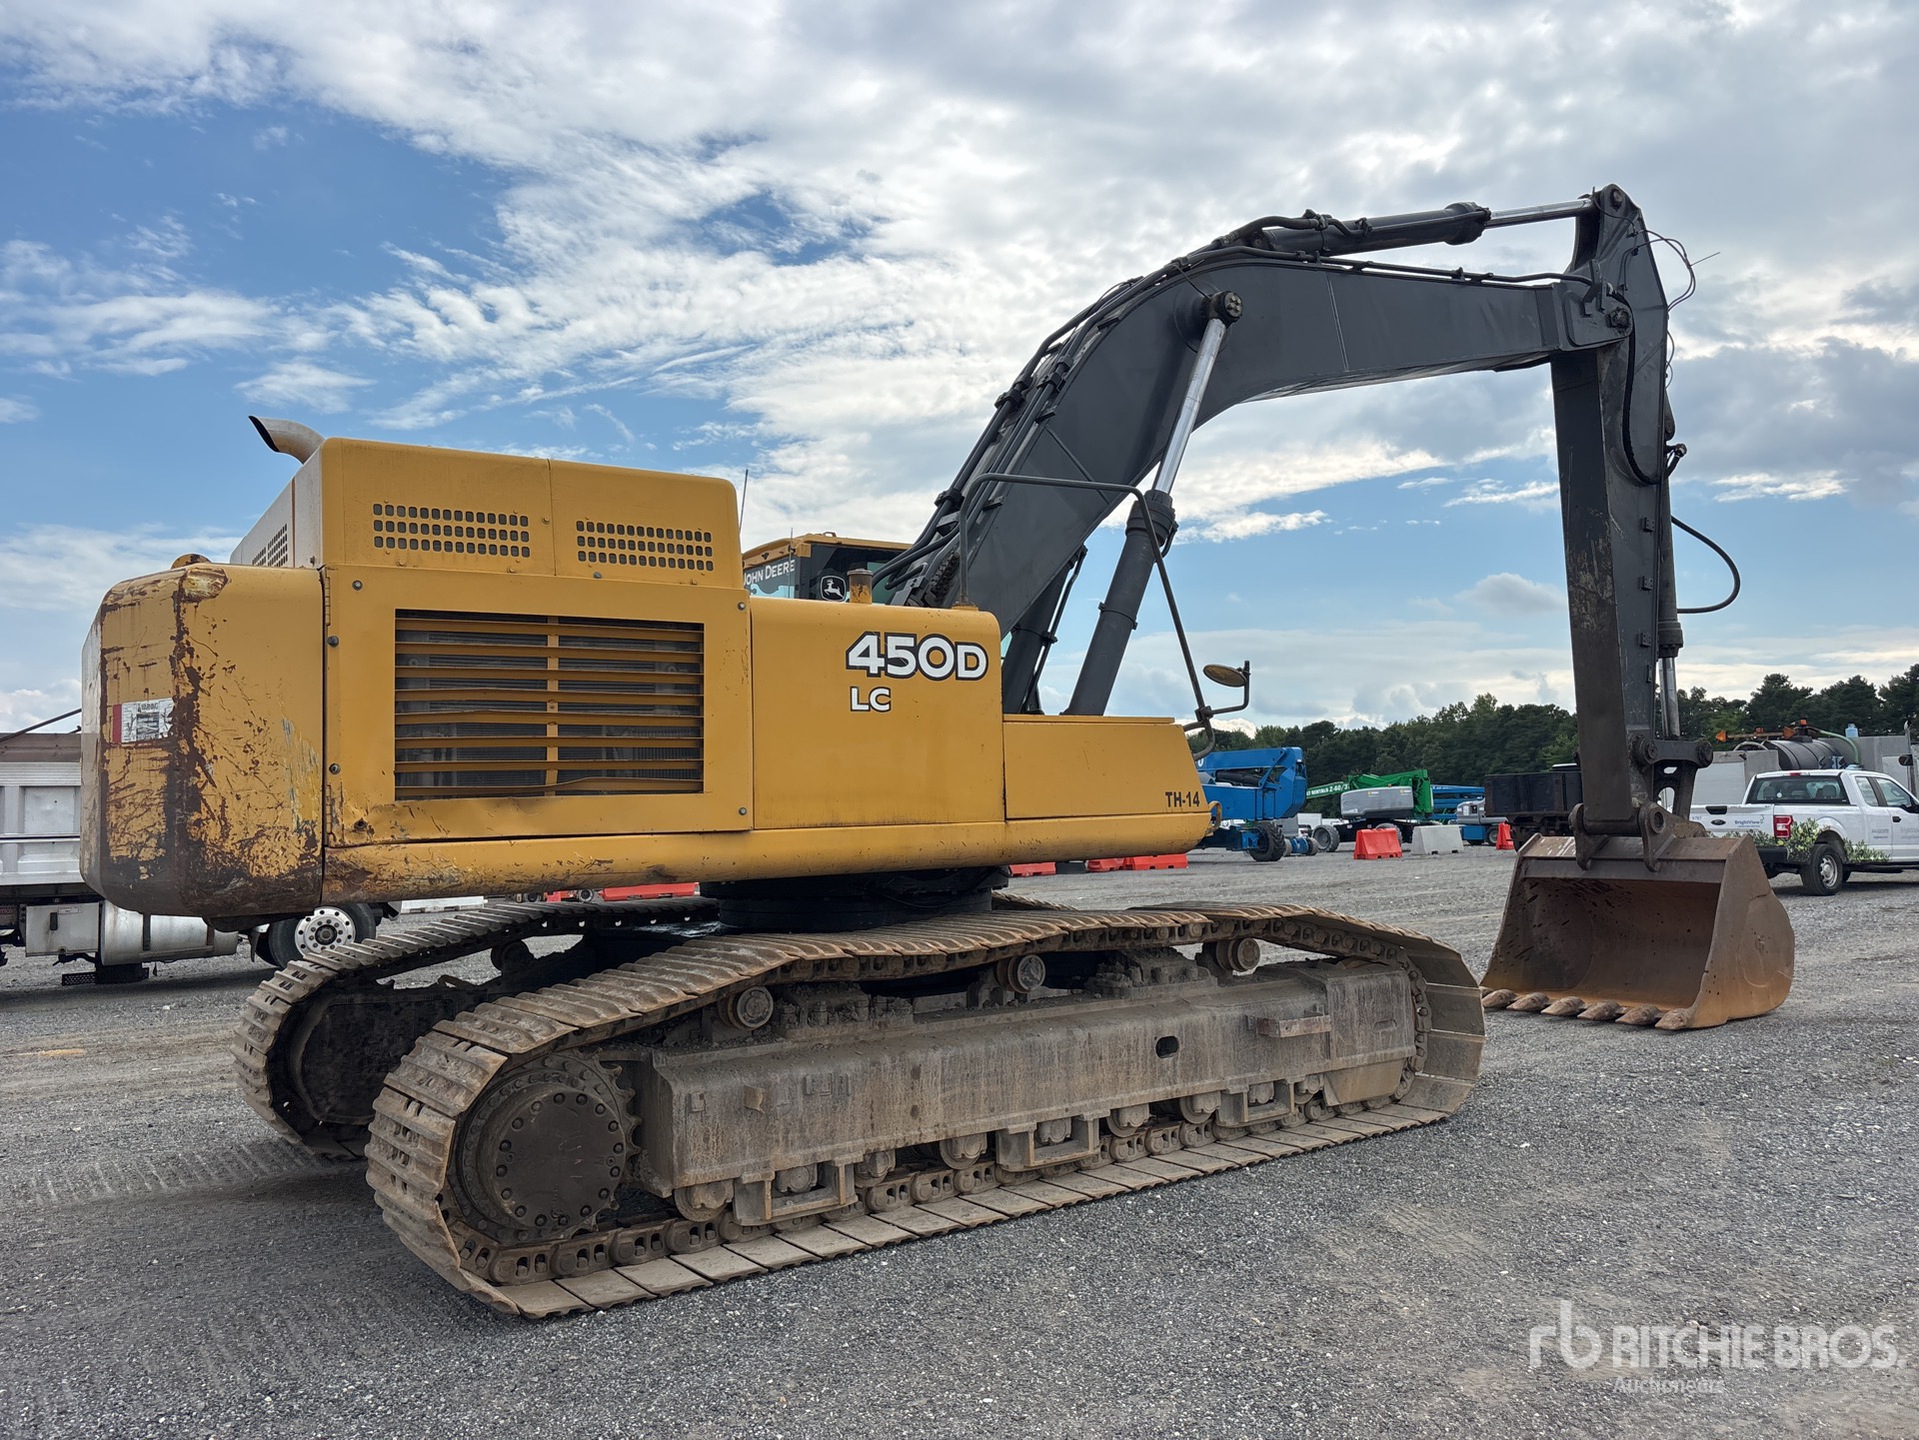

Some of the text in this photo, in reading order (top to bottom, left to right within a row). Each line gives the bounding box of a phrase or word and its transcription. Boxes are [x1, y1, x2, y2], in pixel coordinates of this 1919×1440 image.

[743, 559, 796, 587] JOHN DEERE
[846, 631, 989, 681] 450D
[850, 686, 892, 712] LC
[1165, 791, 1200, 808] TH-14
